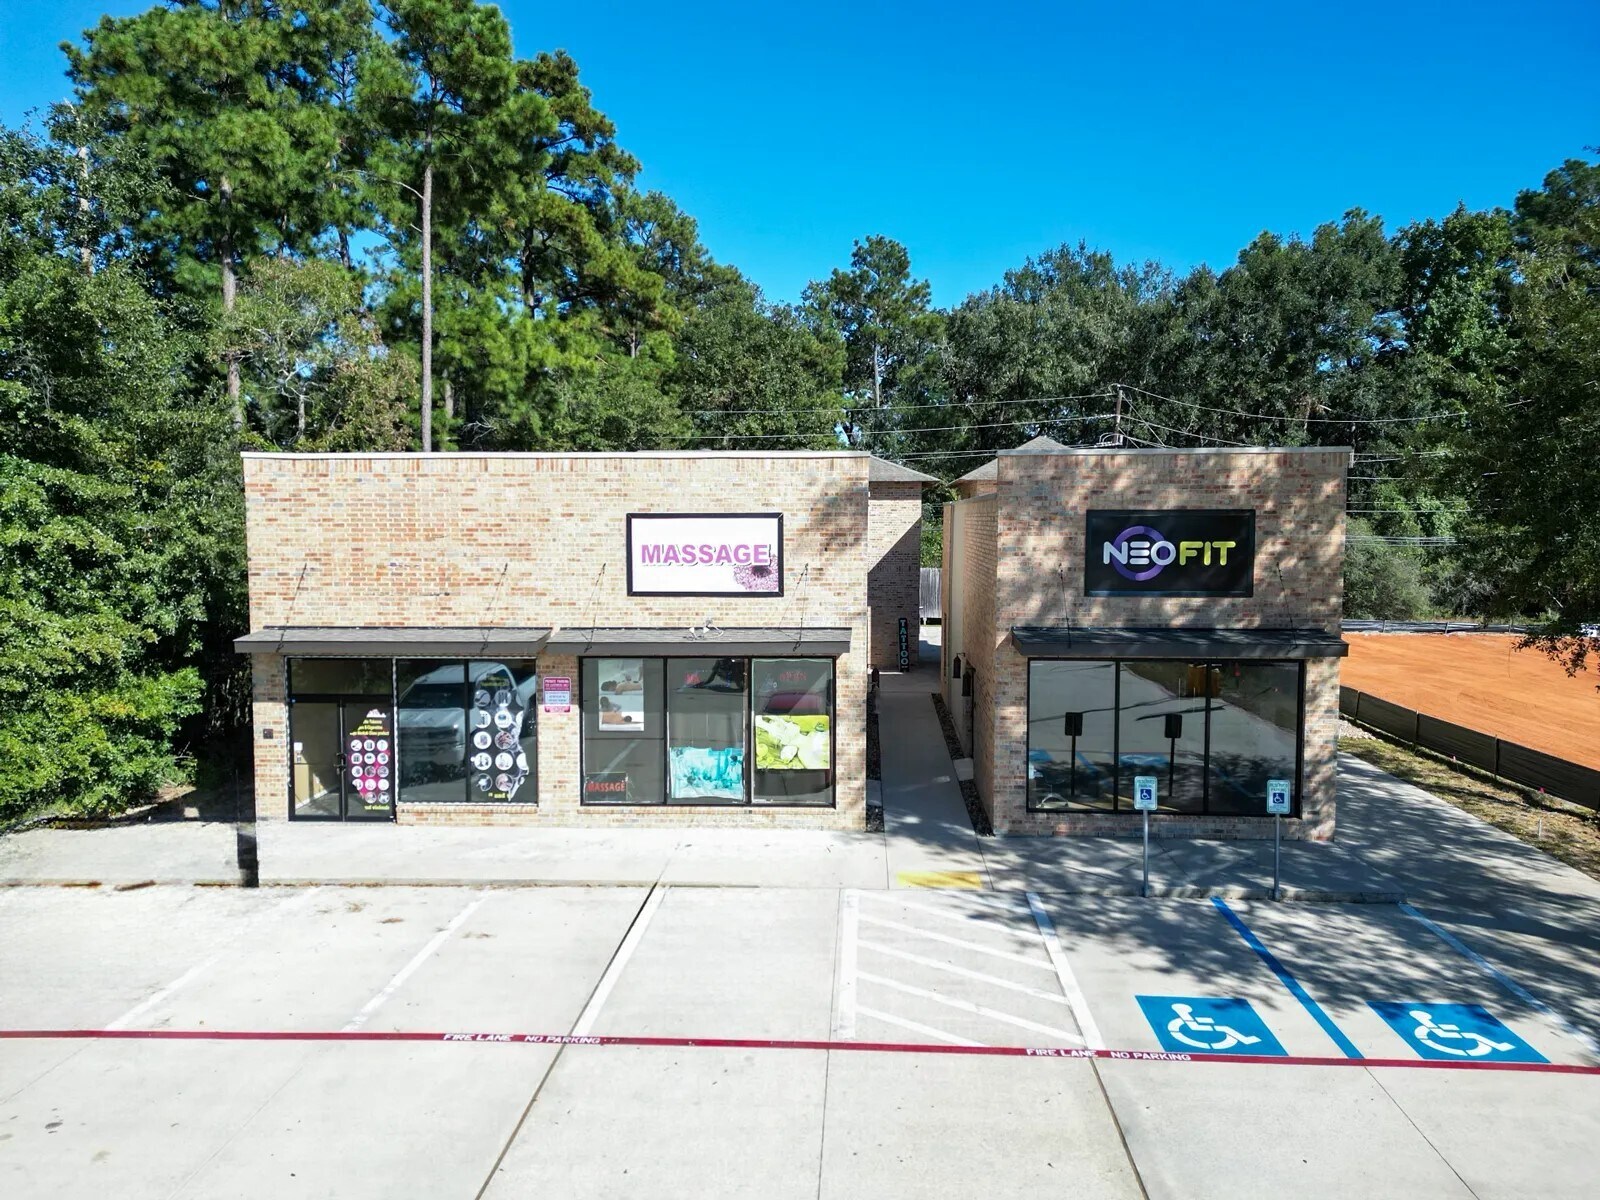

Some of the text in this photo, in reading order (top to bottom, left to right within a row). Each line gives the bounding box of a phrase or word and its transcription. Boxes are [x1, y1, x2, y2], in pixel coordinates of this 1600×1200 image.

[641, 544, 769, 565] MASSAGE
[1103, 540, 1236, 566] NEOFIT
[900, 619, 909, 665] TATTOO
[587, 781, 625, 792] MASSAGE
[443, 1033, 475, 1041] FIRE
[476, 1034, 513, 1042] LANE
[546, 1036, 600, 1045] PARKING
[1026, 1048, 1191, 1061] FIRE LANE NO PARKING
